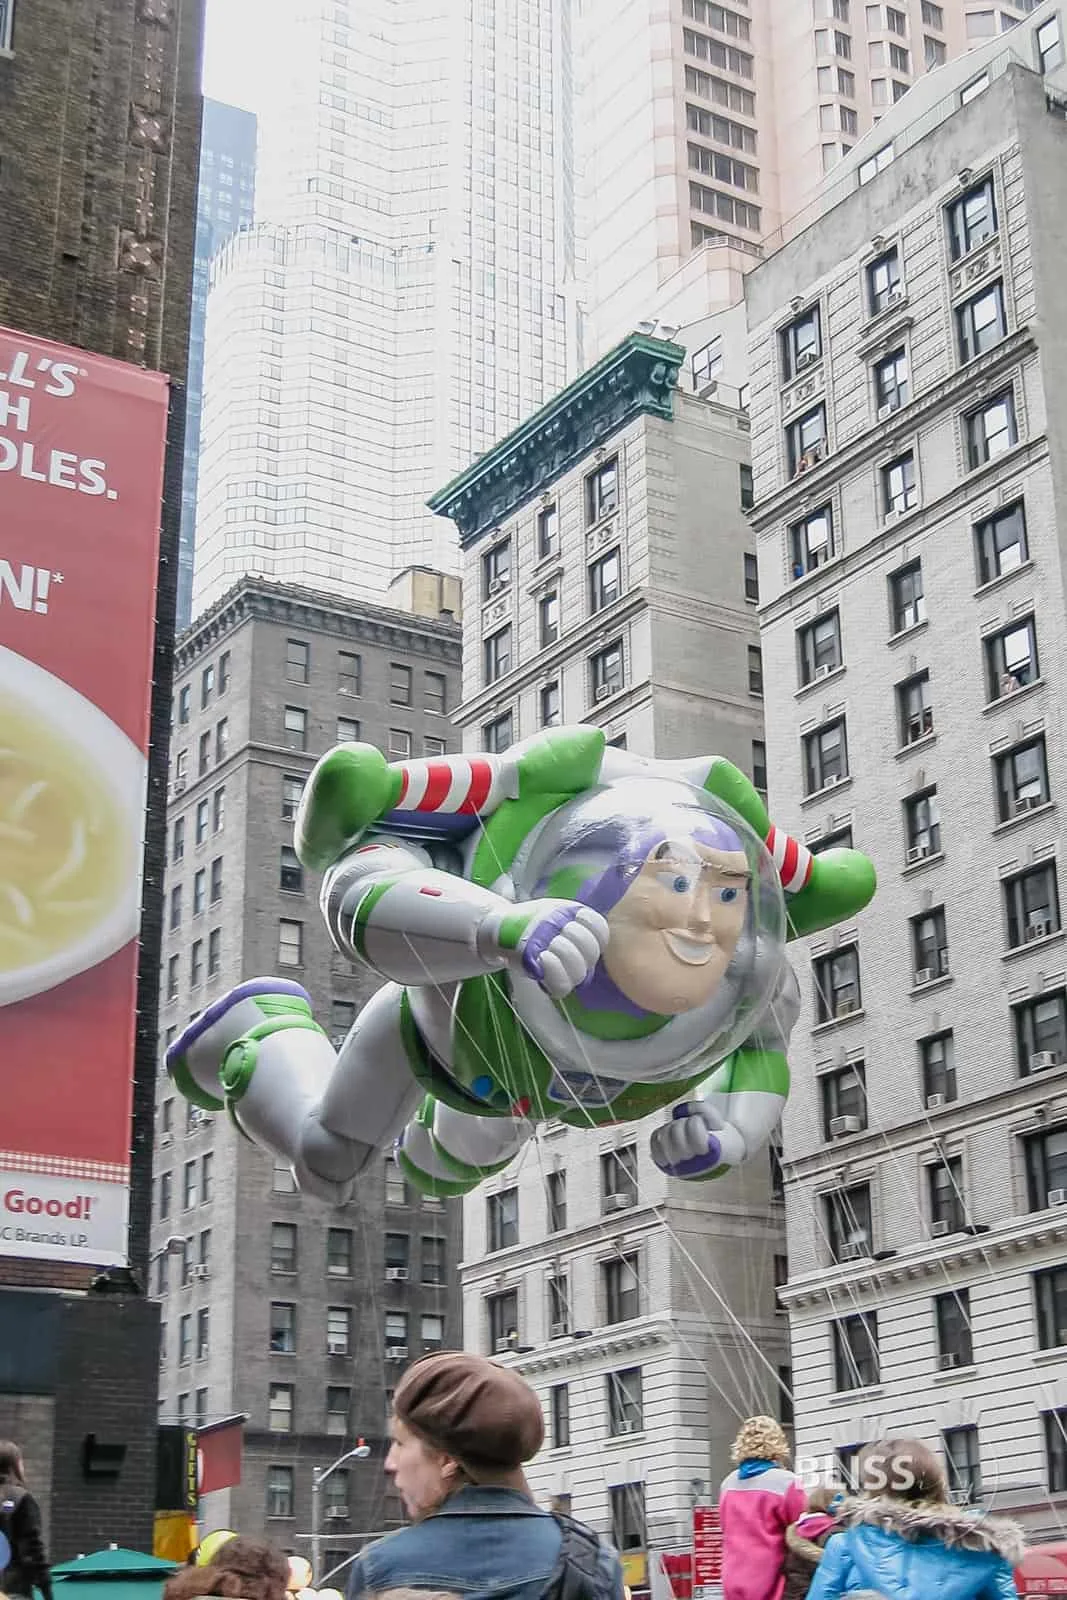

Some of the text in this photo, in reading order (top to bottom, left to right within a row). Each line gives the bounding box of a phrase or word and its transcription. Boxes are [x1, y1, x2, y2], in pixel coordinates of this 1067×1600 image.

[0, 351, 79, 397] L'S
[4, 1189, 91, 1221] Good!
[15, 1227, 66, 1246] Brands
[186, 1431, 198, 1506] GIFTS
